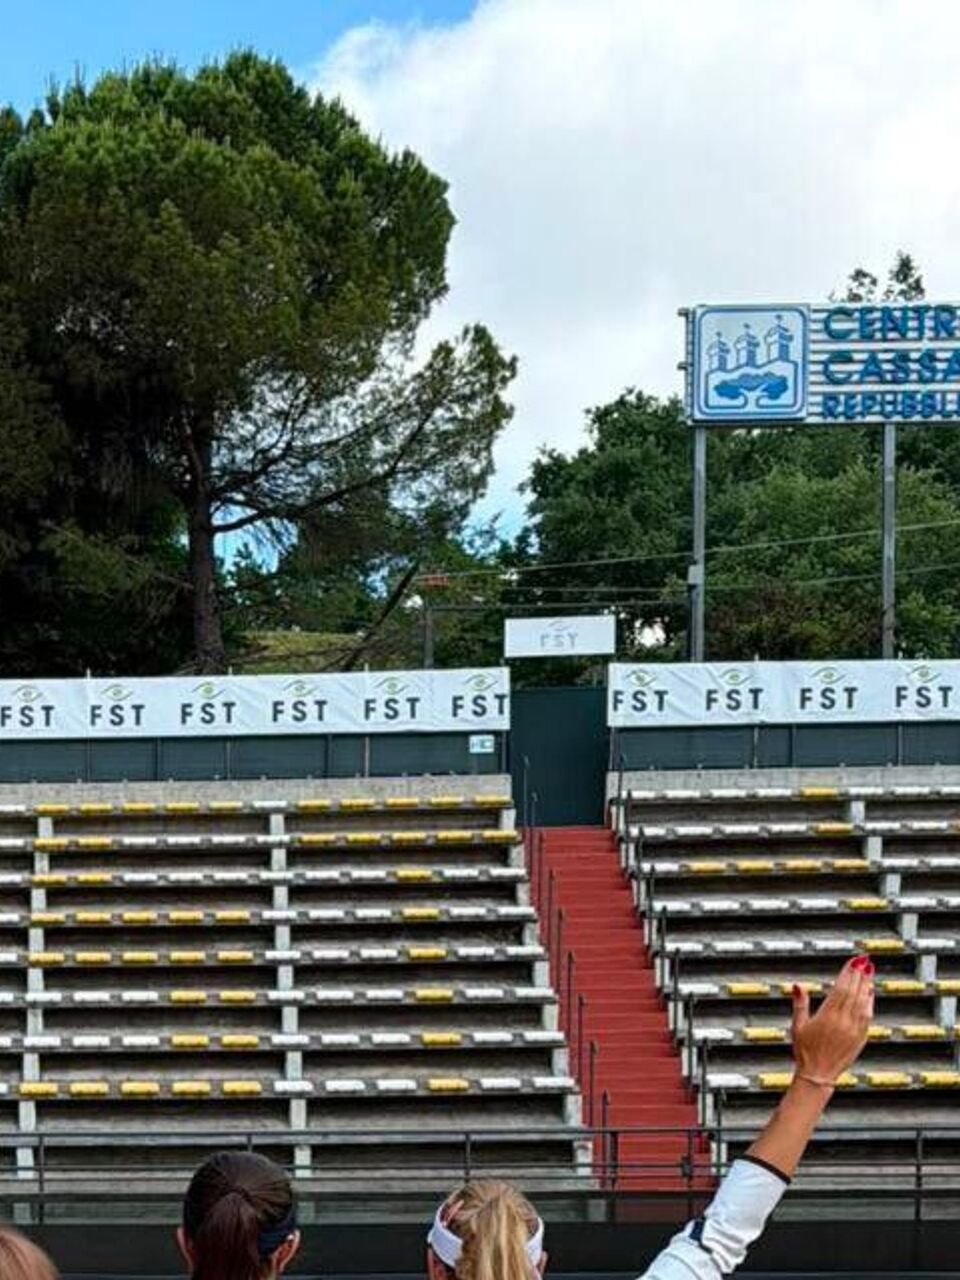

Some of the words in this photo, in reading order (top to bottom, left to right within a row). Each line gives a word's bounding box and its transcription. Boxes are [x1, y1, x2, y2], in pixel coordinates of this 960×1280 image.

[821, 391, 960, 419] REPUBBL
[0, 704, 55, 728] FST
[90, 704, 145, 727] FST
[180, 701, 236, 725] FST
[272, 699, 328, 723] FST
[364, 696, 421, 721] FST
[451, 693, 509, 718] FST
[612, 689, 669, 713] FST
[705, 687, 764, 712] FST
[799, 686, 859, 710] FST
[895, 685, 953, 709] FST
